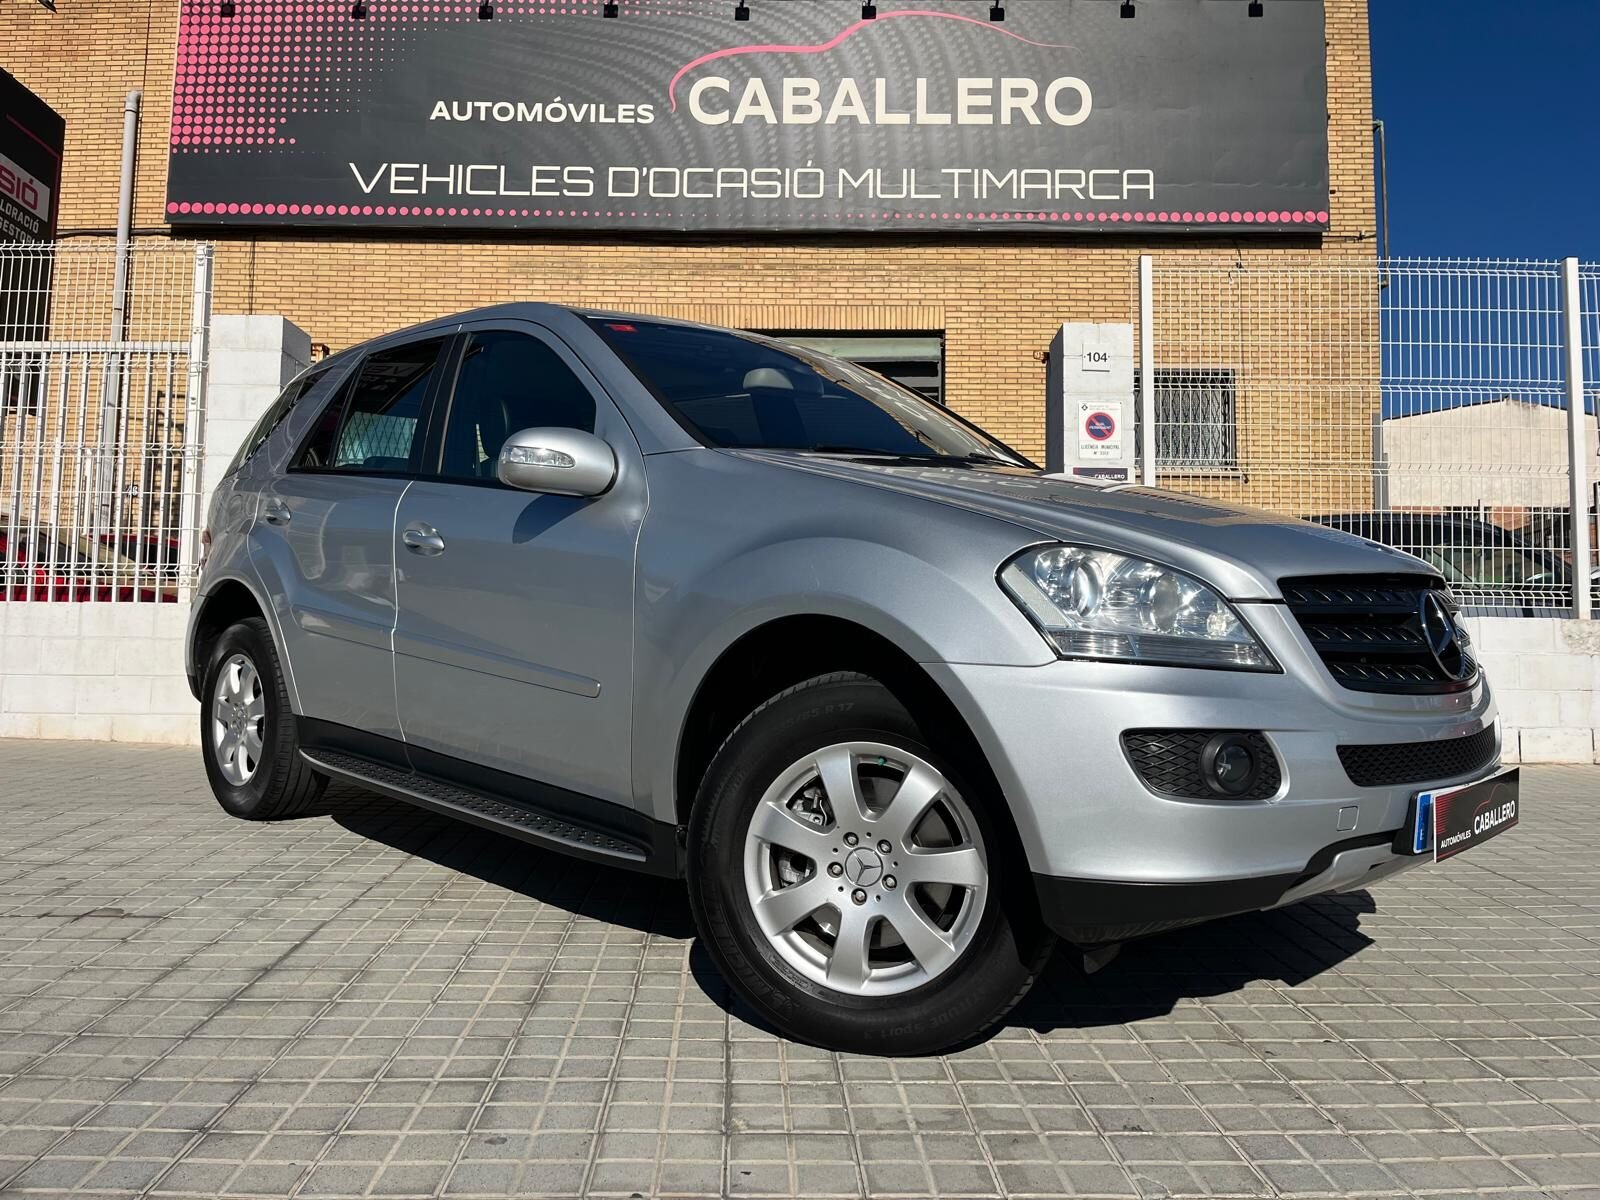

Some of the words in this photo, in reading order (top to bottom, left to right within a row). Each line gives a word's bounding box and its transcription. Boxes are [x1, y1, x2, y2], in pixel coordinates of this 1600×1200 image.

[430, 96, 655, 124] AUTOMÓVILES
[688, 76, 1093, 126] CABALLERO
[349, 162, 595, 197] VEHICLES
[607, 160, 825, 199] D'OCASIÓ
[838, 168, 1155, 200] MULTIMARCA
[1087, 352, 1108, 362] 104
[1441, 830, 1472, 848] AUTOMÓVILES
[1474, 800, 1515, 834] CABALLERO
